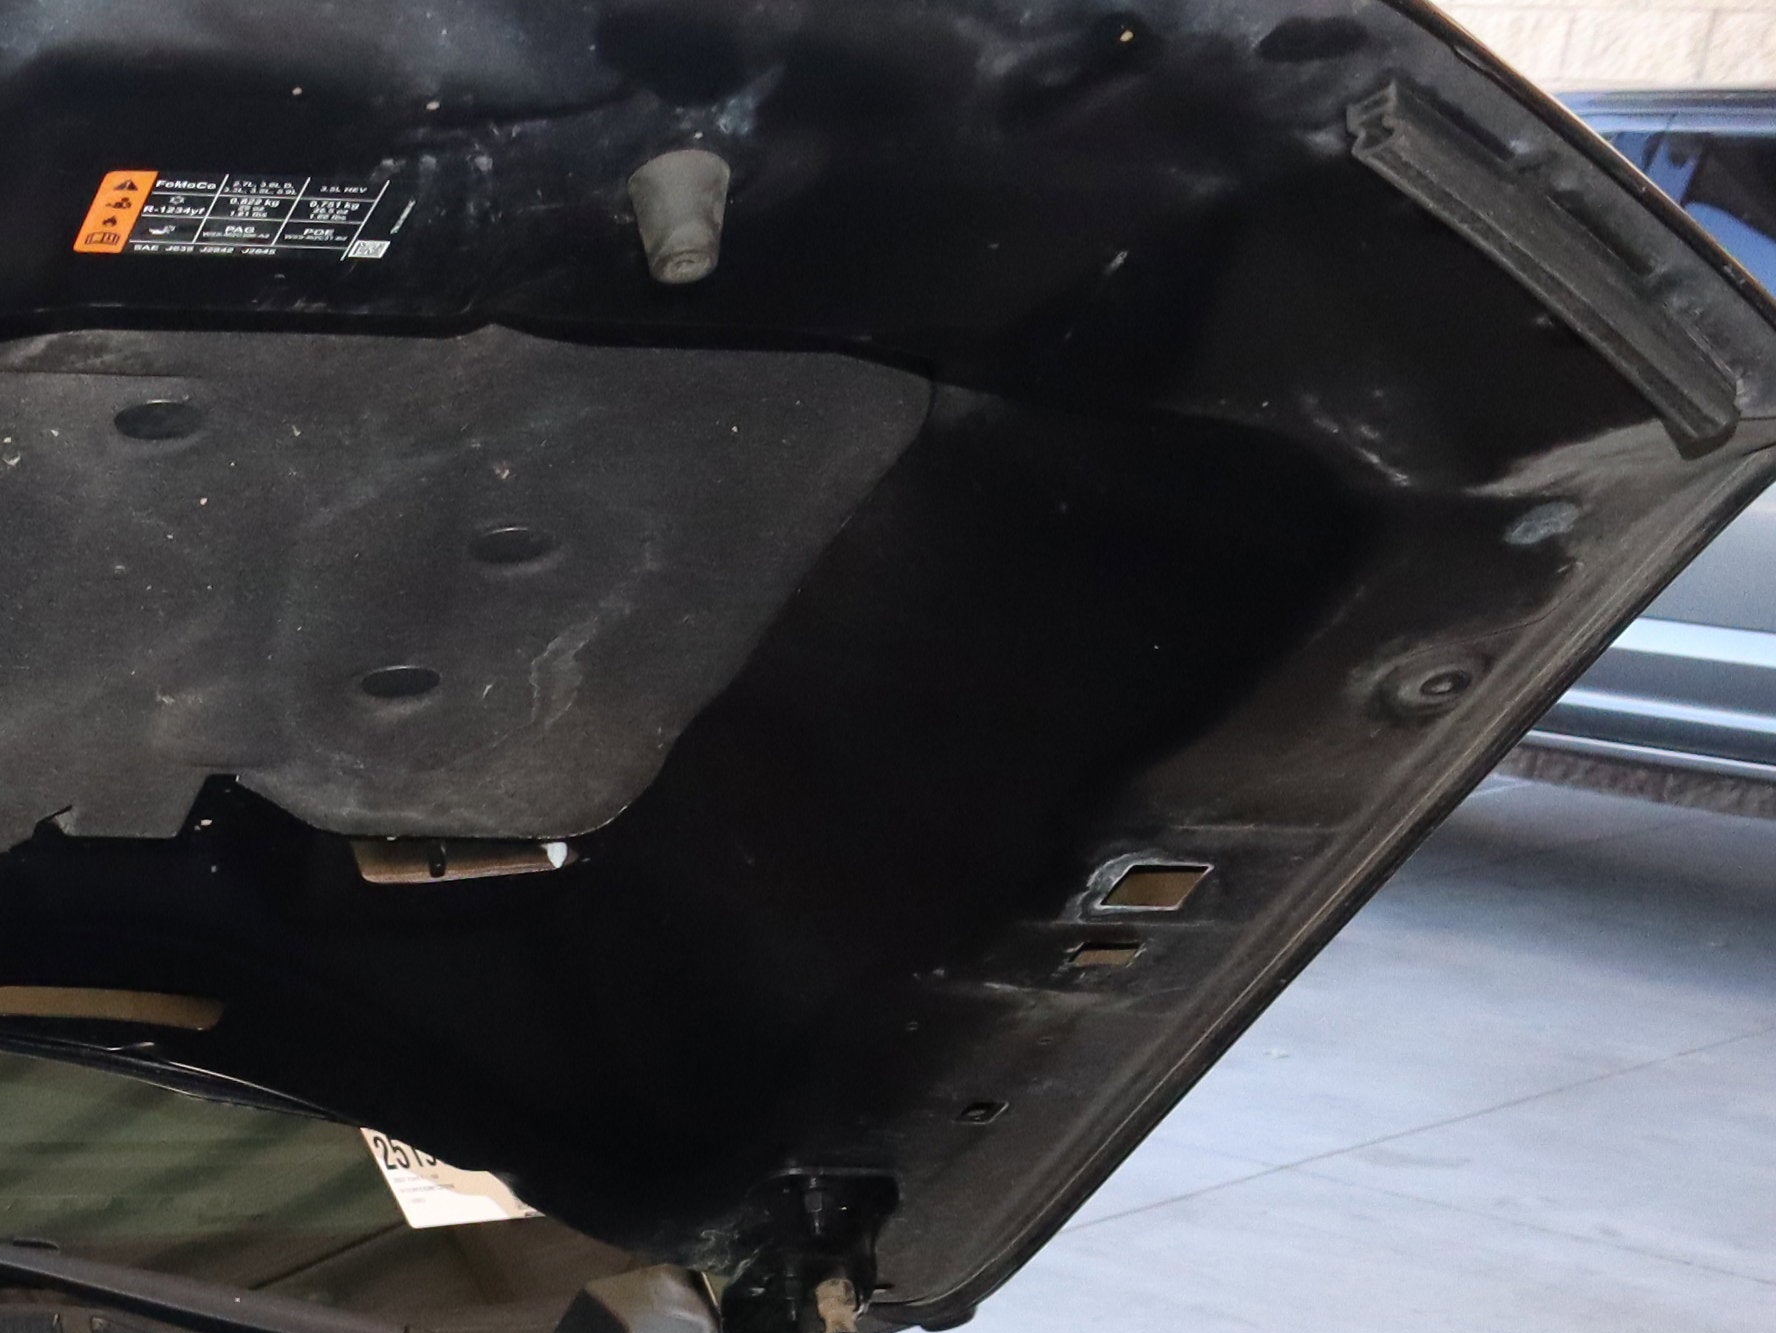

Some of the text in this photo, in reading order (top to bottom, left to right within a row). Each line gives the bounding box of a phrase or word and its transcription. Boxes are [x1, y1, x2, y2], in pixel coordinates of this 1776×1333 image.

[155, 180, 217, 189] FoMoCo
[264, 199, 280, 207] kg
[341, 202, 359, 210] kg
[141, 205, 204, 215] R-1234yf
[223, 225, 256, 233] PAG
